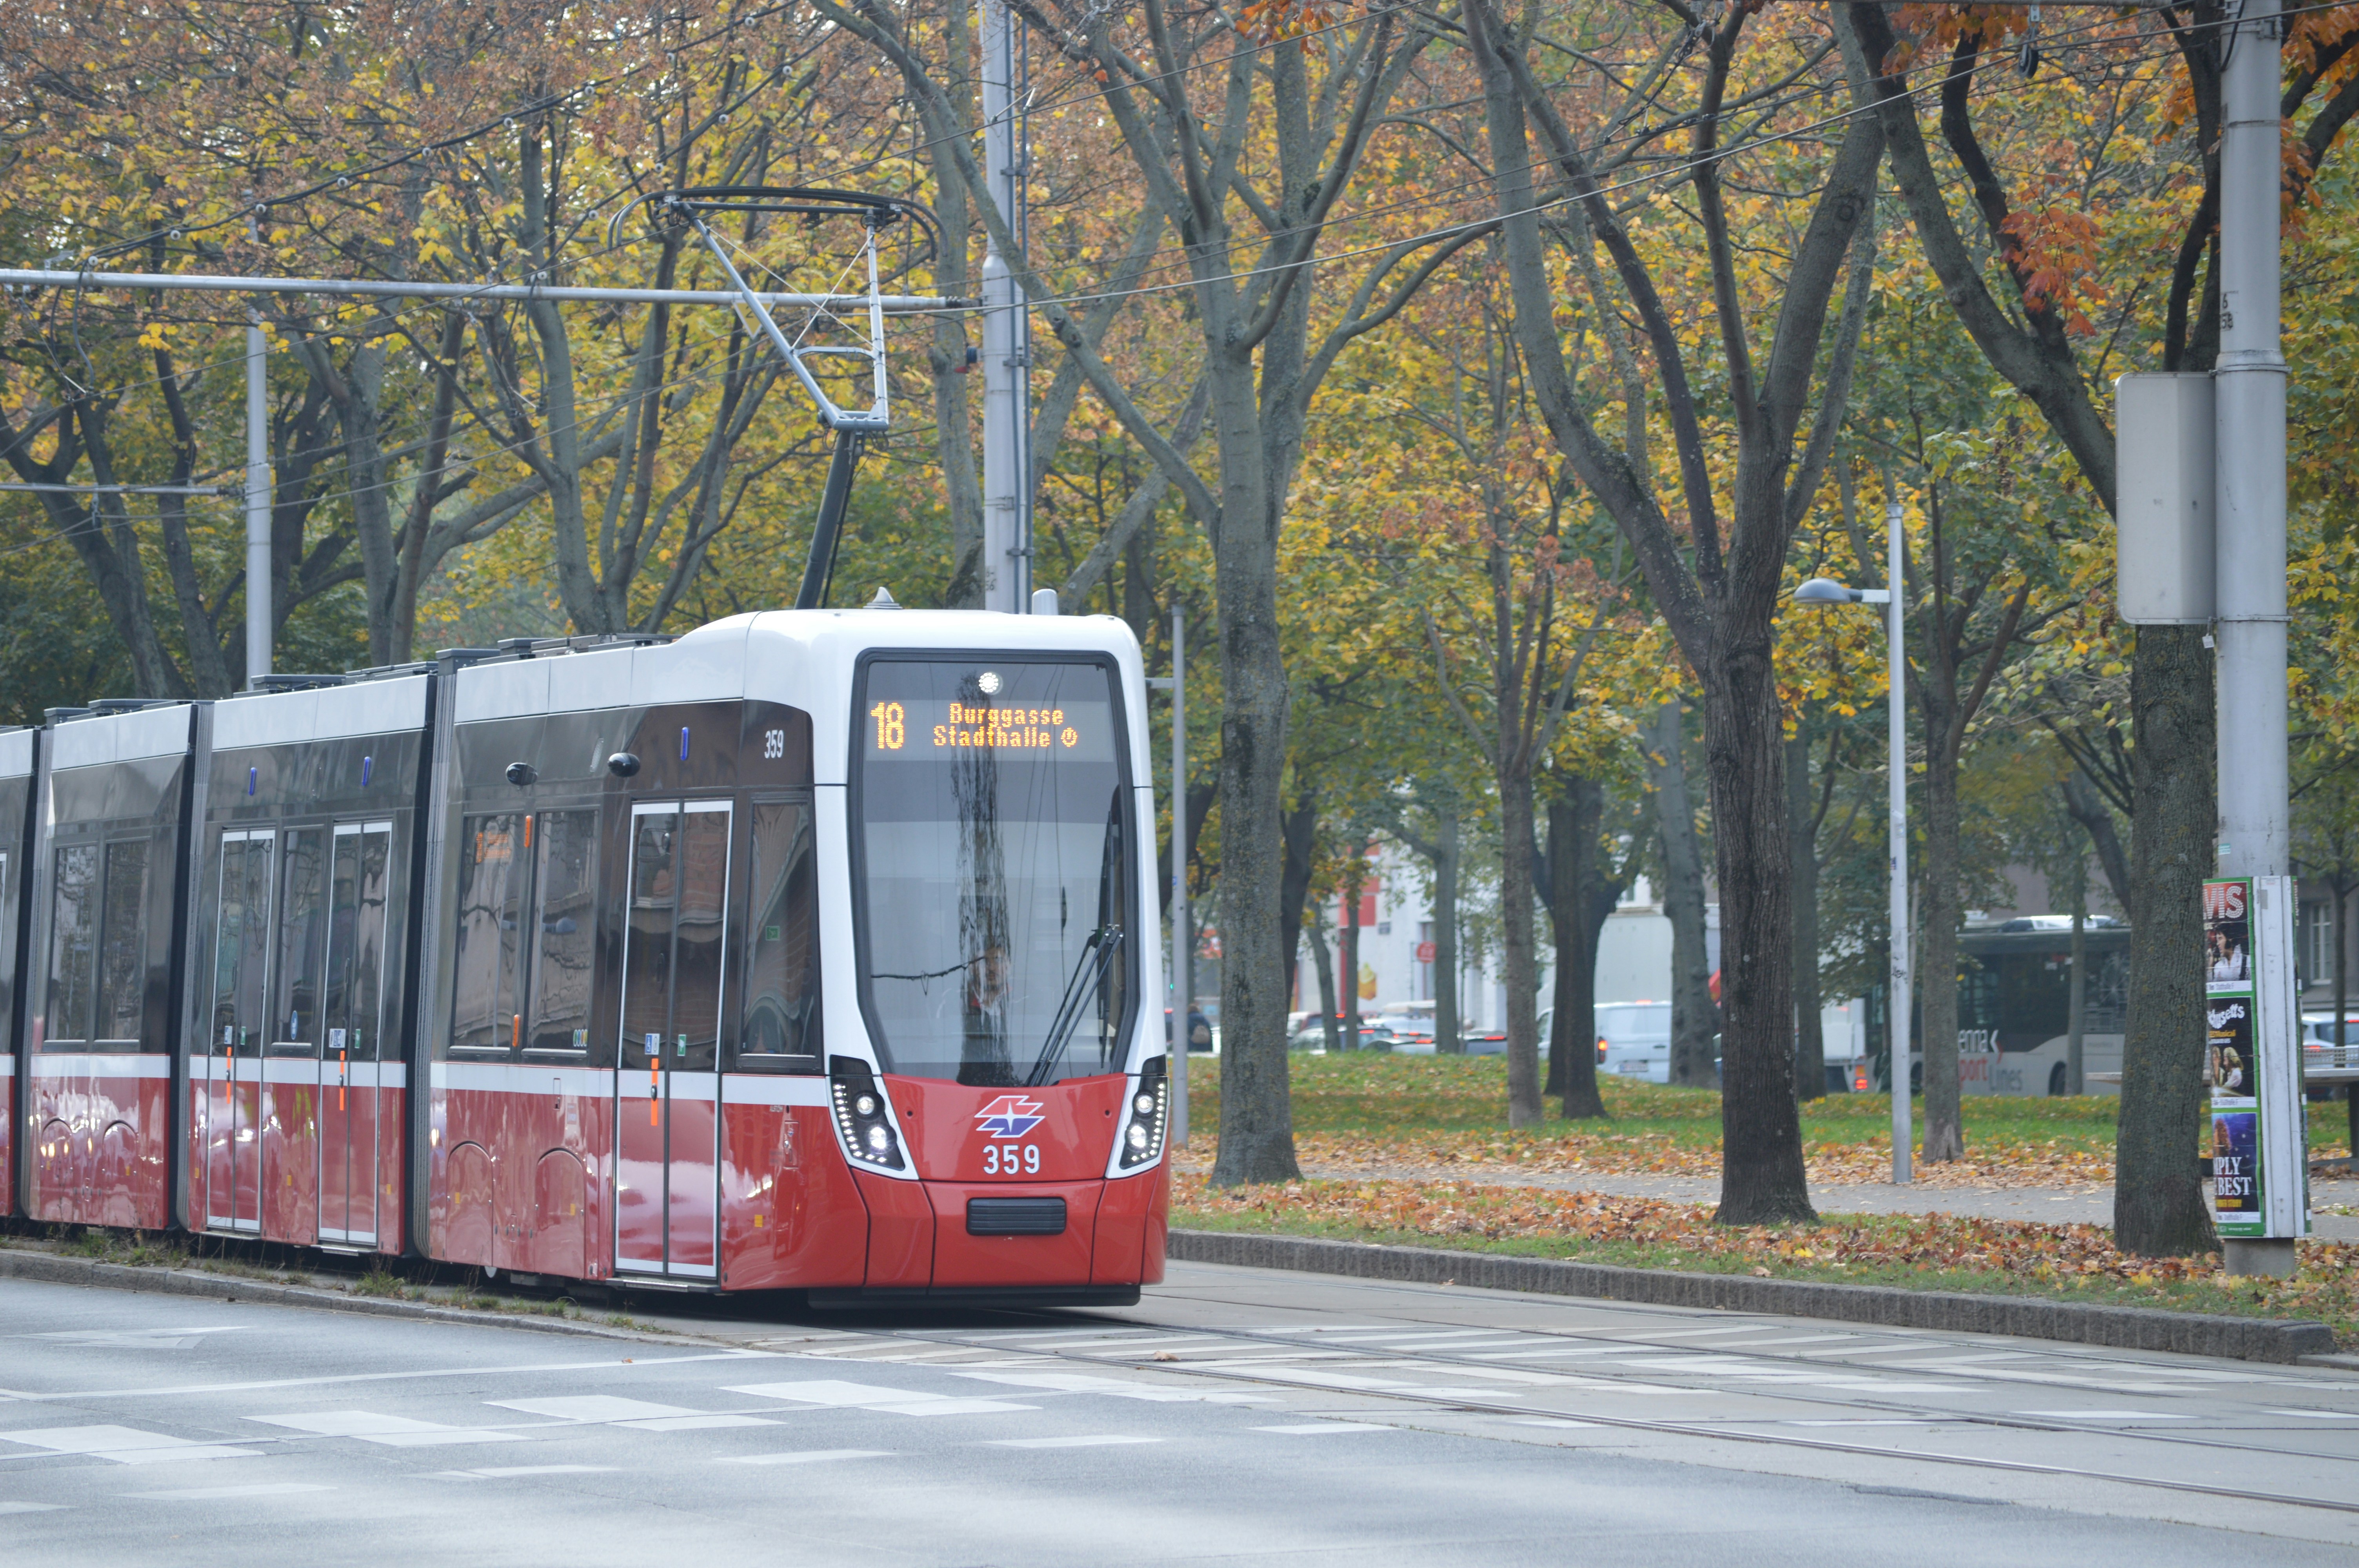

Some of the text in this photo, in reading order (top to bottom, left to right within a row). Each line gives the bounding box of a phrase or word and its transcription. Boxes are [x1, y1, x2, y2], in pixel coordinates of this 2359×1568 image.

[870, 702, 903, 749] 18
[949, 703, 1063, 728] Burggasse
[764, 730, 784, 759] 359
[933, 725, 1050, 746] Stadthalle
[2203, 885, 2244, 920] VIS
[982, 1144, 1040, 1175] 359
[2218, 1177, 2252, 1196] BEST
